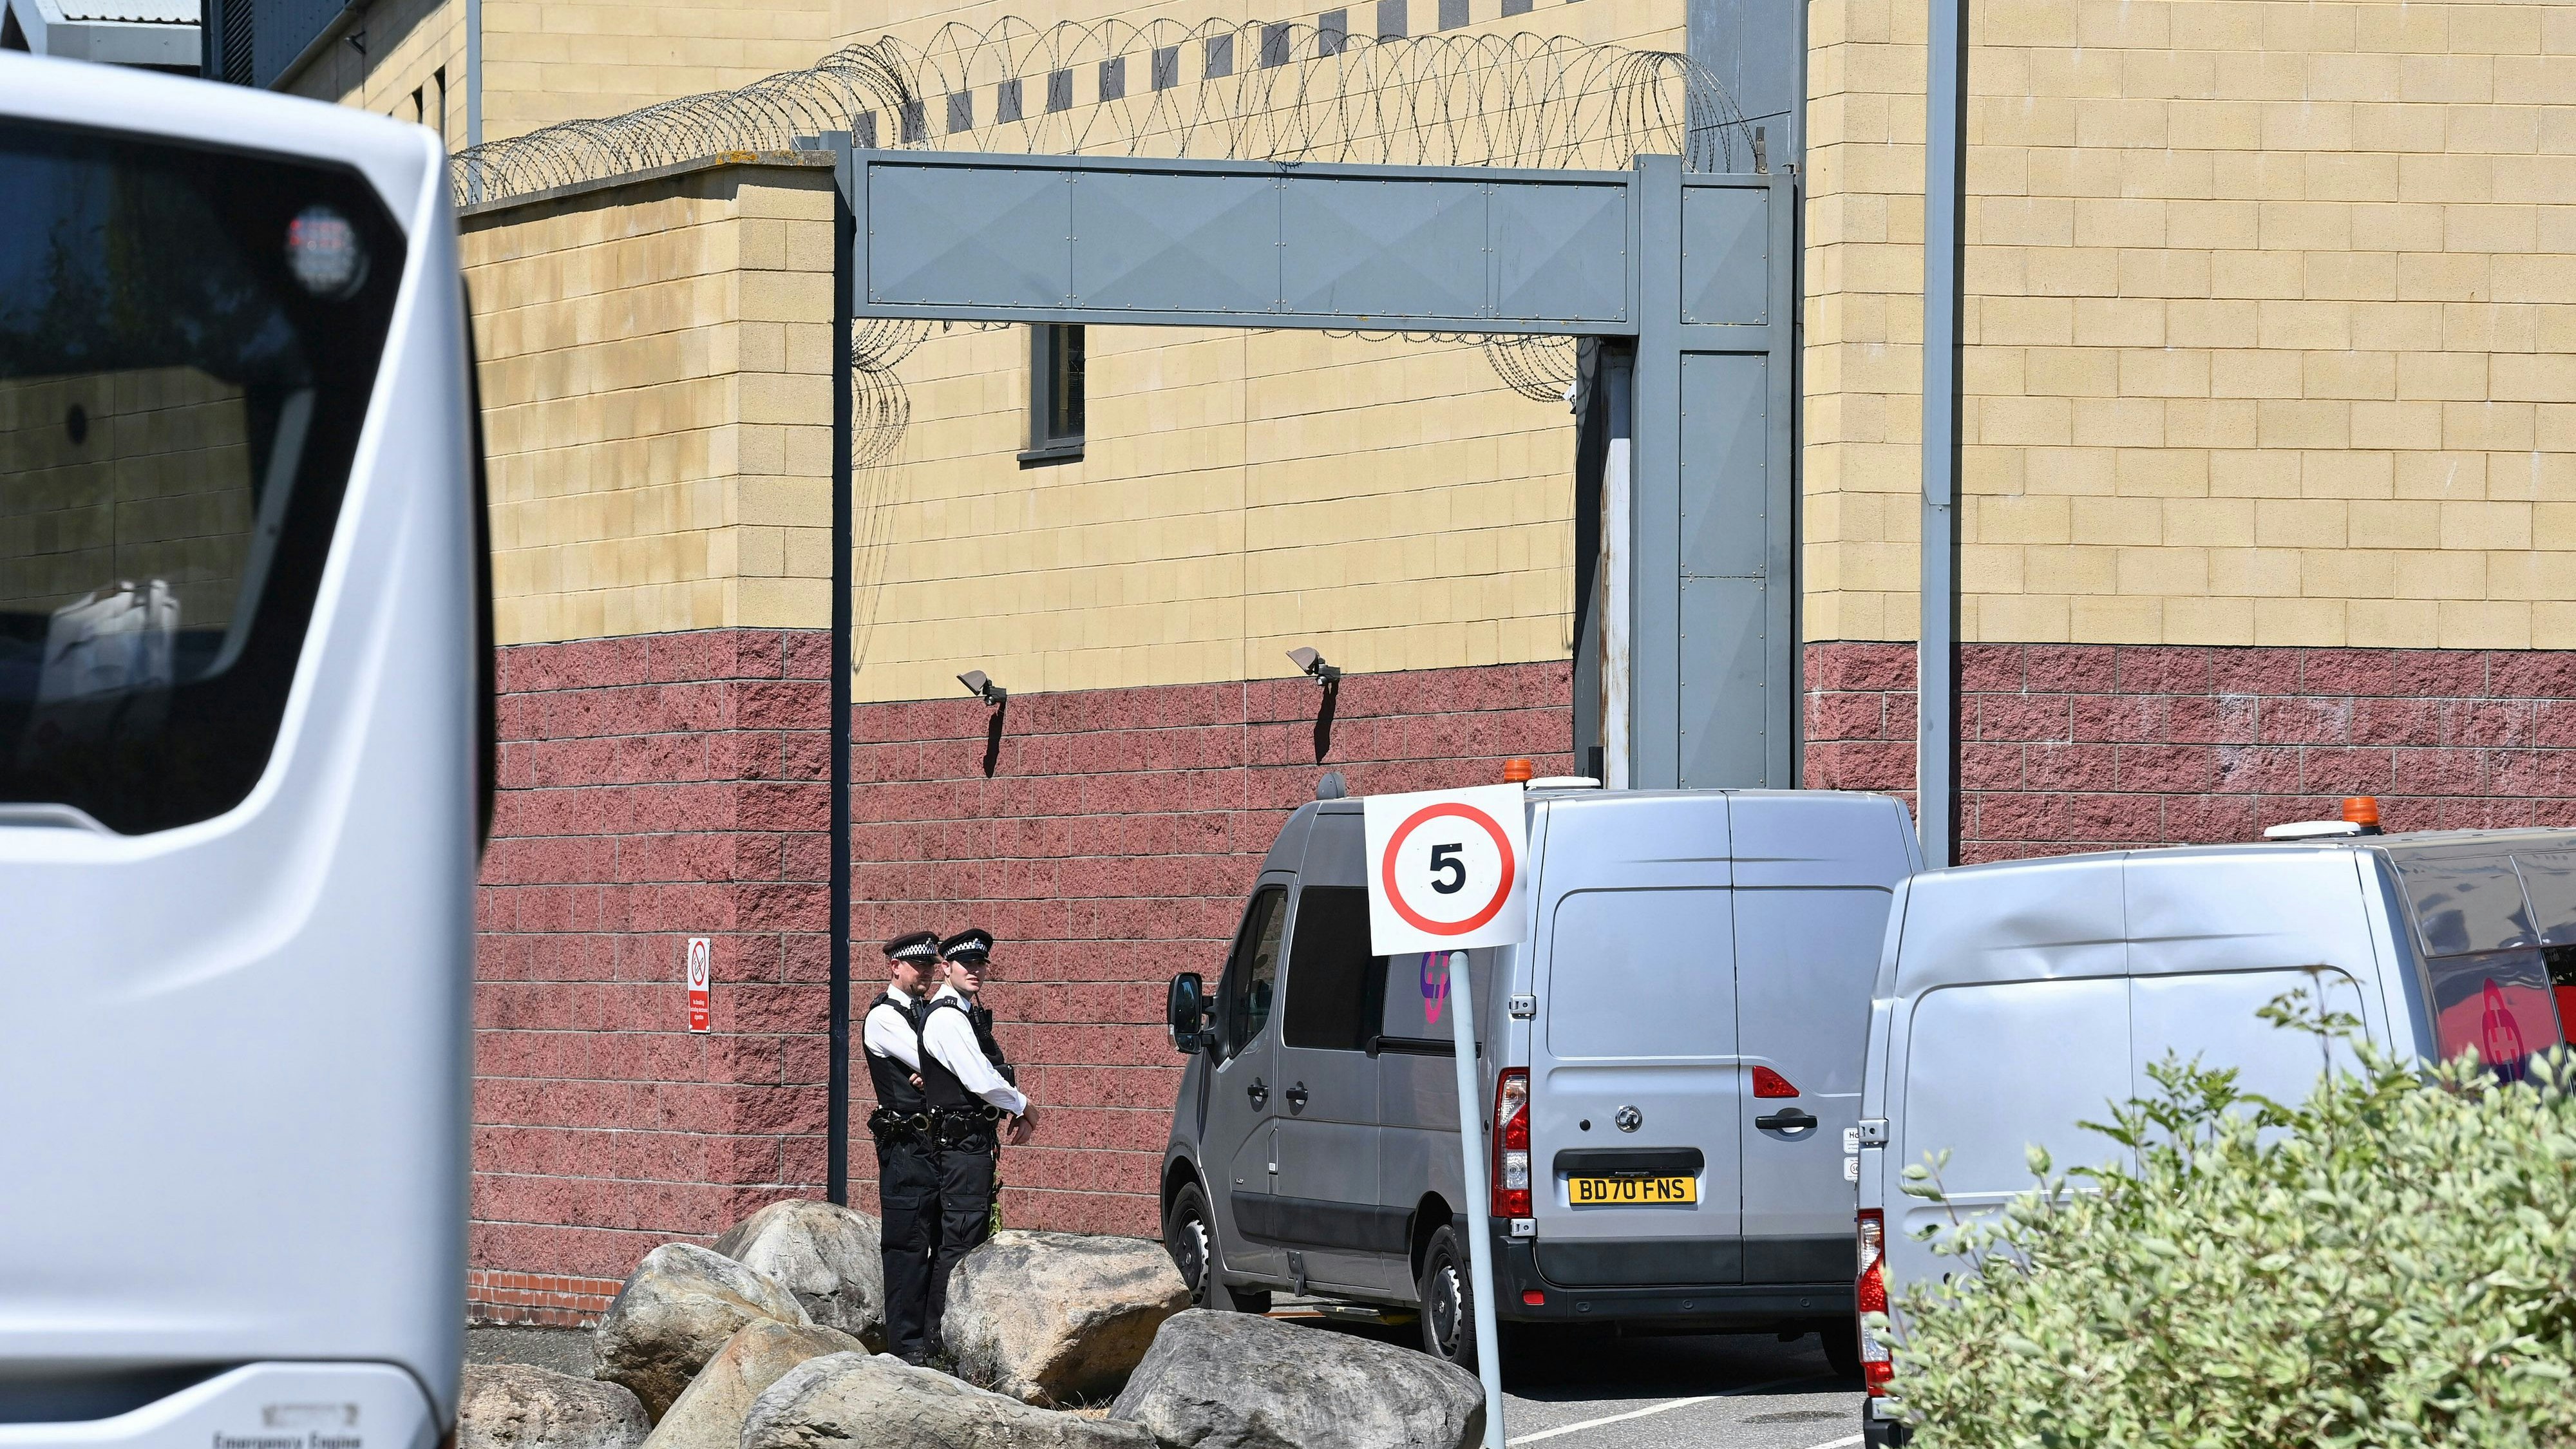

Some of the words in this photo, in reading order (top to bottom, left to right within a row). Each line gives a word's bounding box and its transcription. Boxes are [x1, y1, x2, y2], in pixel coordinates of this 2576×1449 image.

[1430, 842, 1466, 894] 5
[1579, 1179, 1636, 1200] BD70
[1642, 1179, 1685, 1199] FNS
